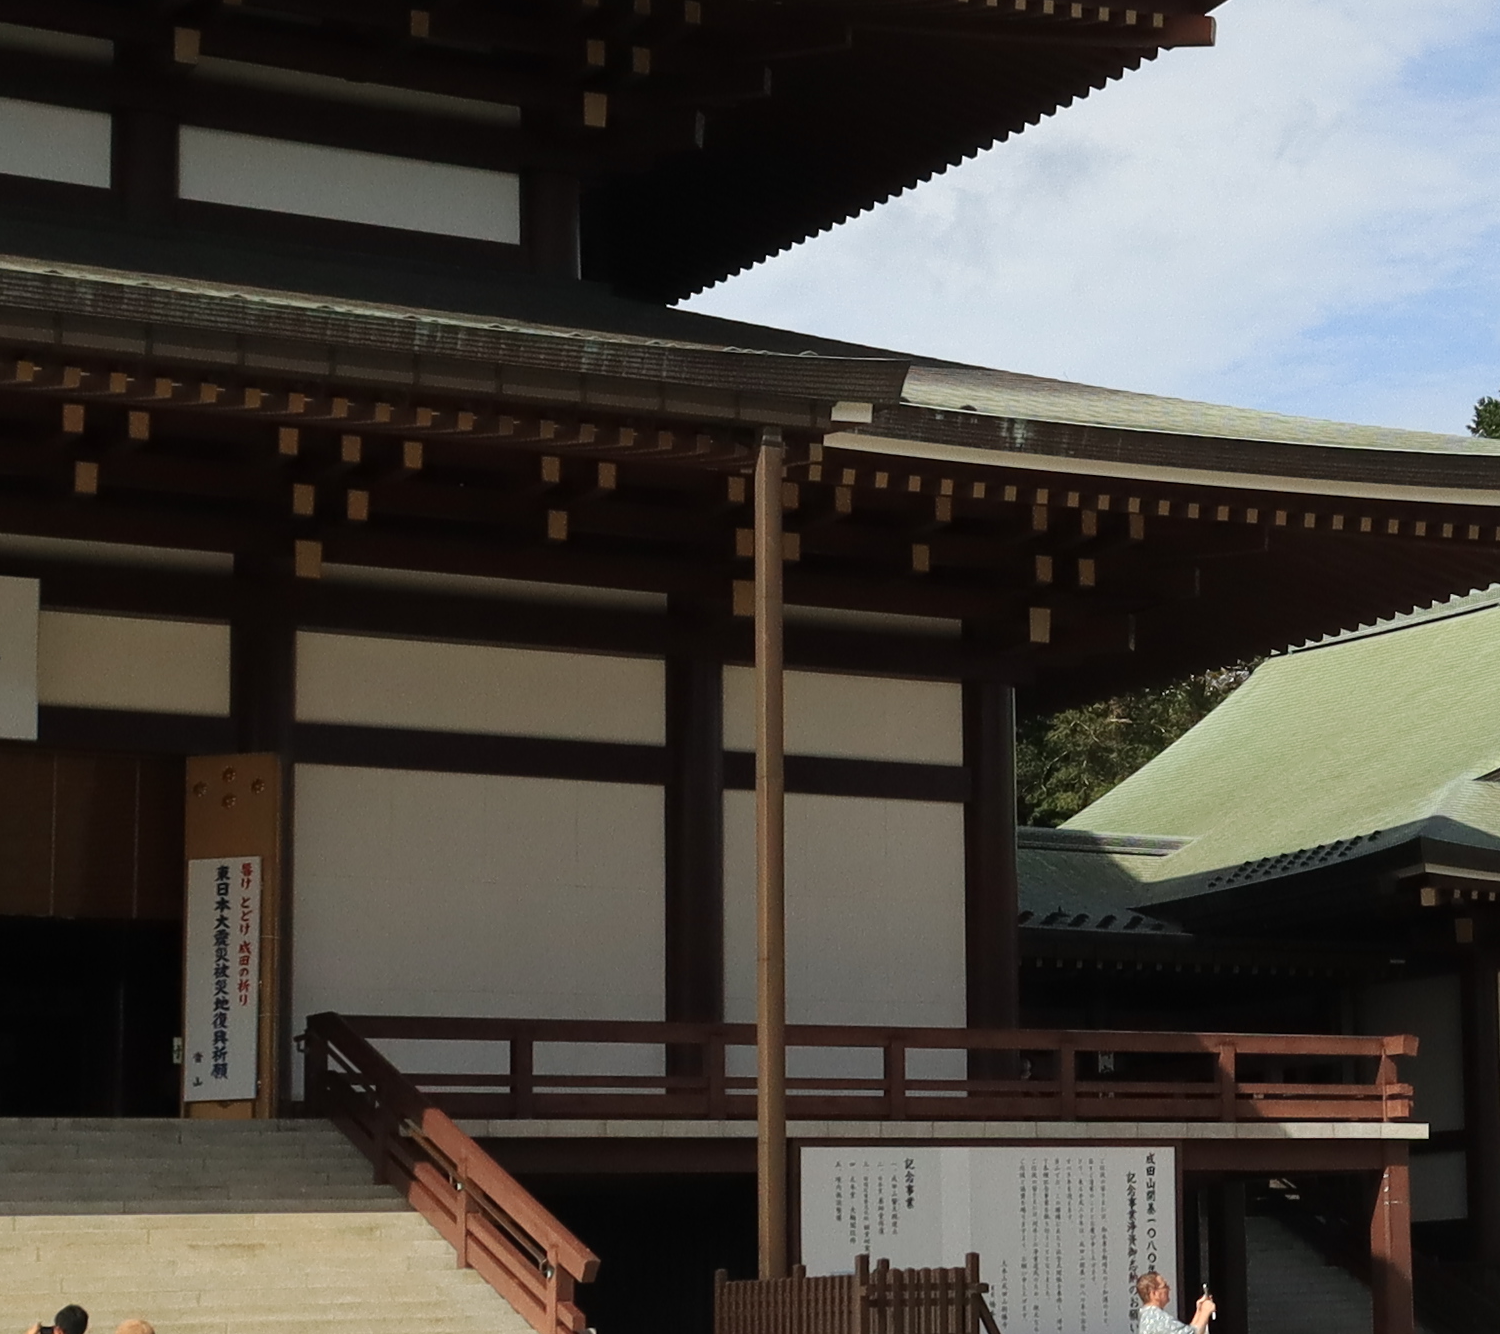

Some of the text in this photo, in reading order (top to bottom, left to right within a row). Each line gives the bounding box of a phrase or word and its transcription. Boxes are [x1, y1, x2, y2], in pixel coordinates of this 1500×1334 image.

[210, 865, 232, 1080] 東日本大震災被災地復興祈願
[237, 941, 252, 1006] 成田の祈り
[904, 1158, 916, 1210] 記念事業
